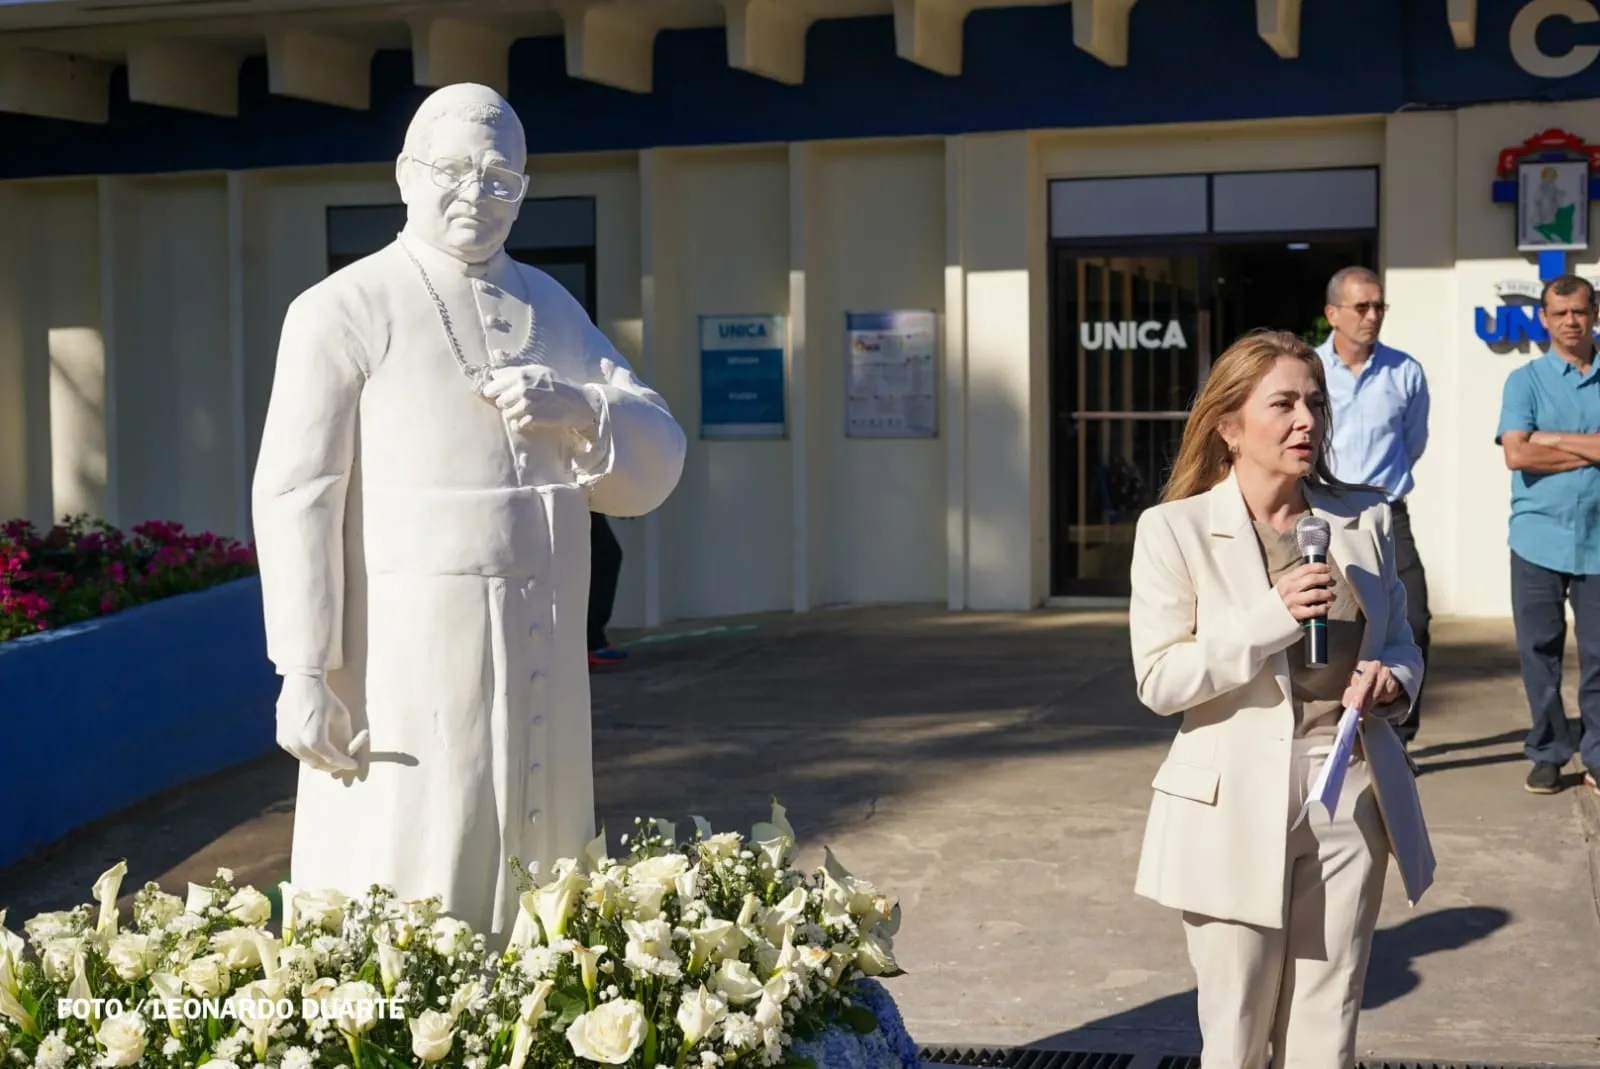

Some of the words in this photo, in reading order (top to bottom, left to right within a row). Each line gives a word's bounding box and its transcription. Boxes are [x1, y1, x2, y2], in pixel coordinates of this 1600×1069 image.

[718, 322, 768, 339] UNICA
[1079, 319, 1188, 350] UNICA
[1474, 304, 1552, 344] UN
